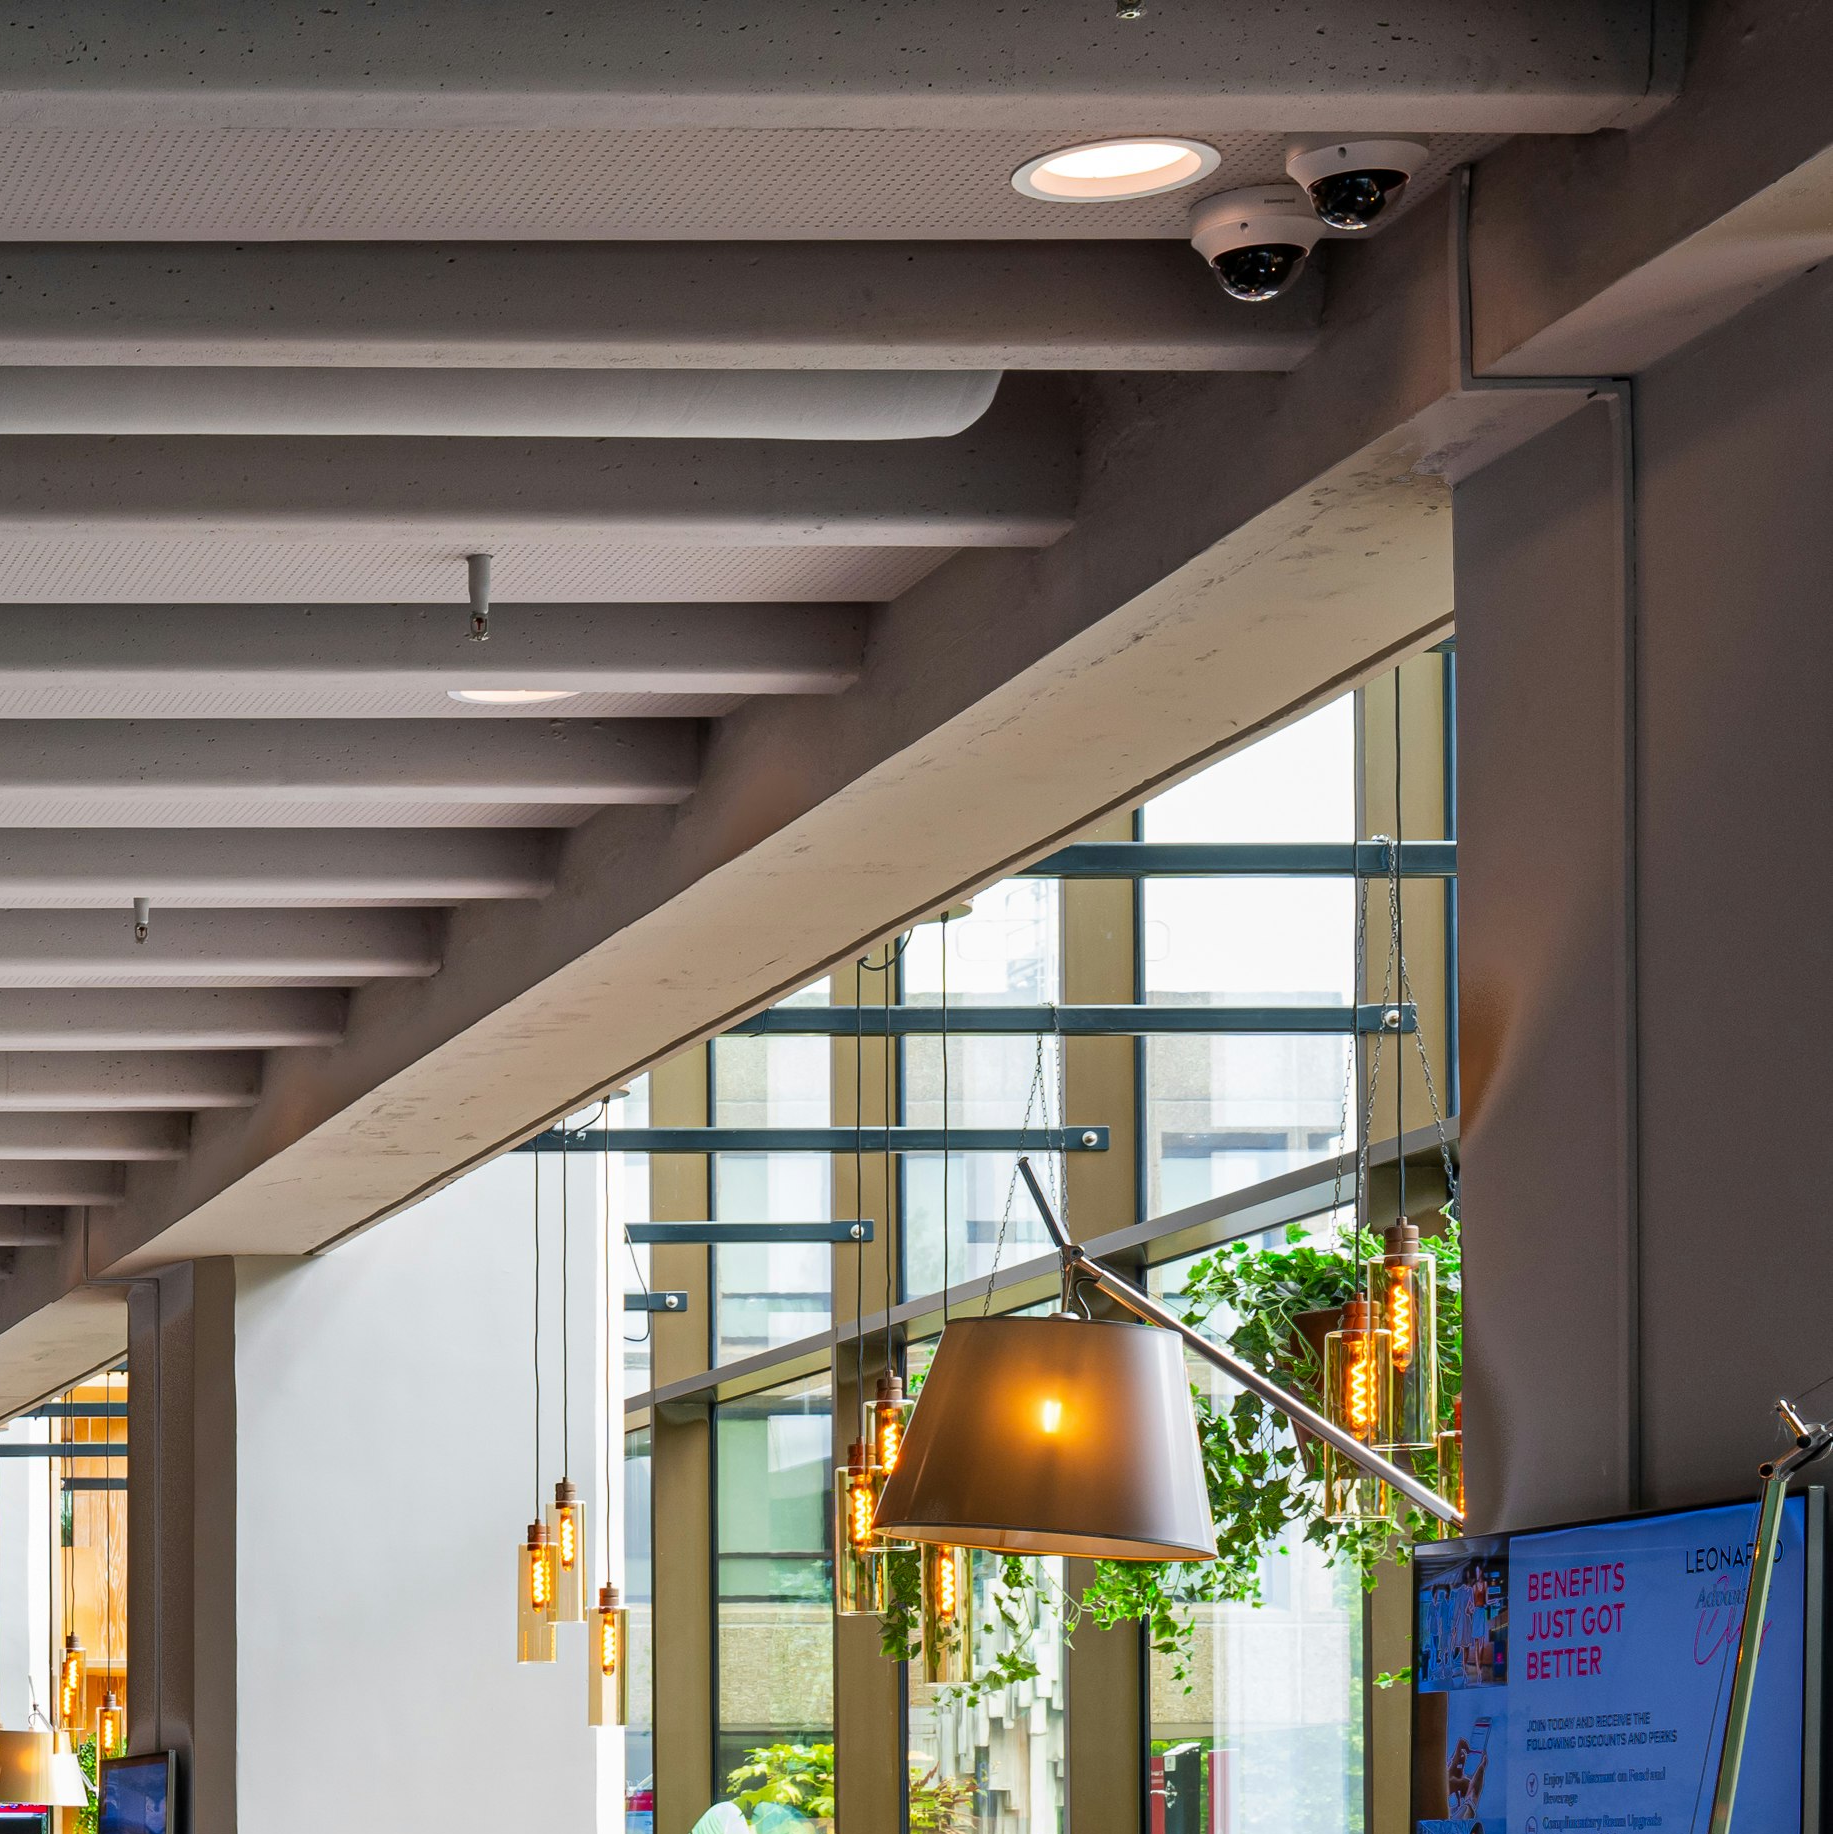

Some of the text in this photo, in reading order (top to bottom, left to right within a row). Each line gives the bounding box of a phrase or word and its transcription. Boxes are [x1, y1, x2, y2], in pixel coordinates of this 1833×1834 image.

[1527, 1562, 1625, 1601] BENEFITS
[1526, 1603, 1625, 1642] JUST GOT
[1526, 1645, 1602, 1681] BETTER
[1526, 1712, 1651, 1733] JOIN TODAY AND RECEIVE THE
[1526, 1729, 1678, 1751] FOLLOWING DISCOUNTS AND PERKS
[1543, 1773, 1564, 1788] Enjoy
[1629, 1767, 1649, 1782] Food
[1650, 1766, 1666, 1780] and
[1543, 1791, 1578, 1806] Beverage
[1627, 1812, 1662, 1830] Upgrade
